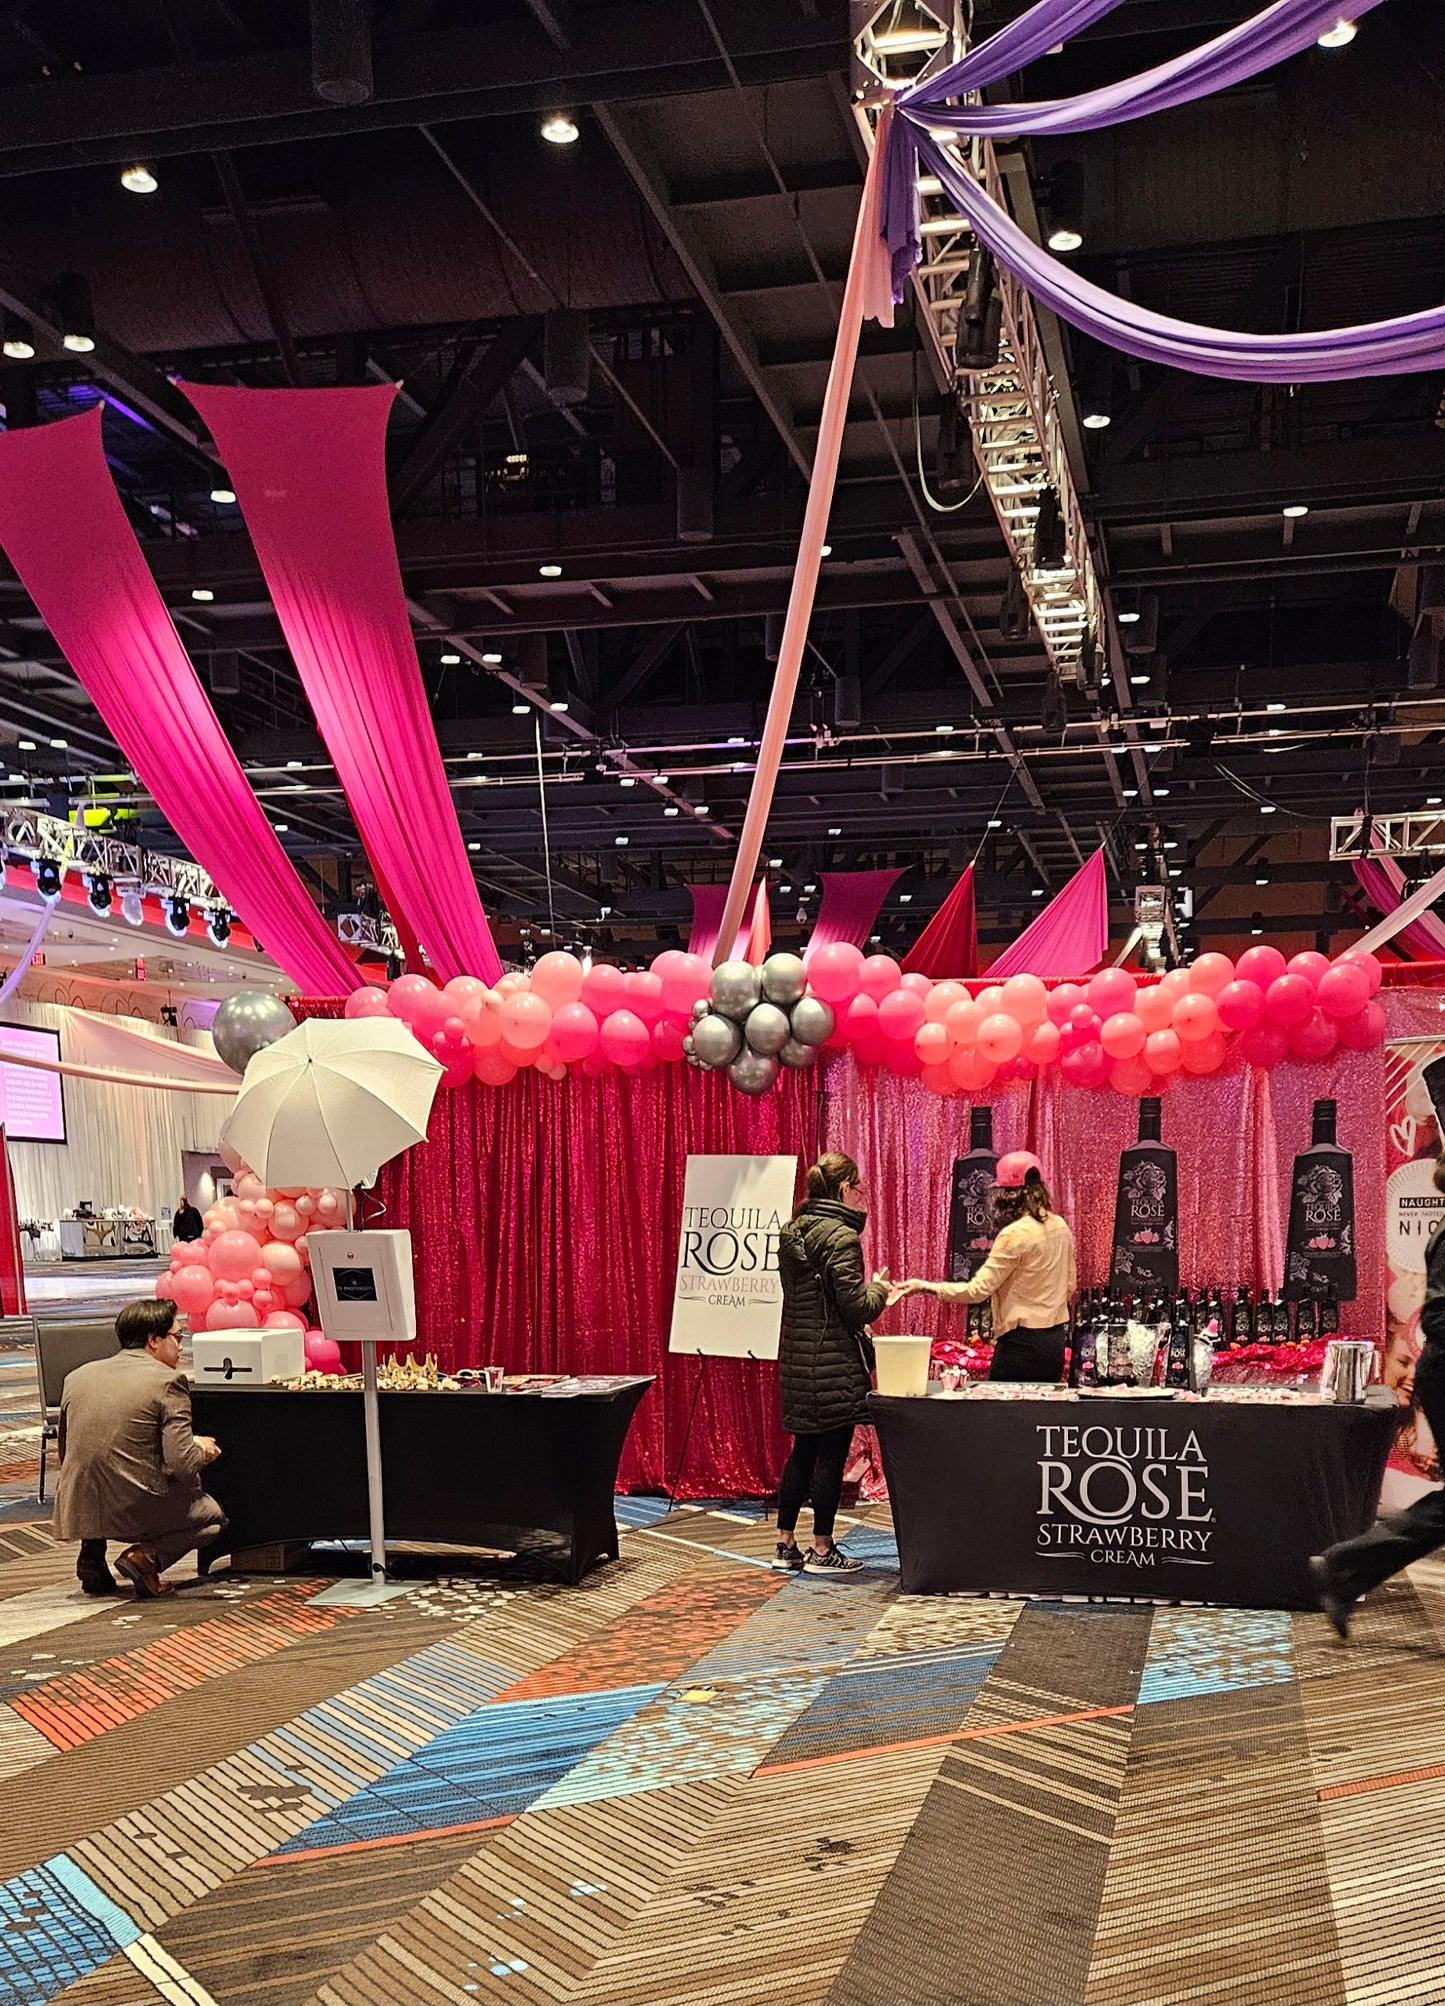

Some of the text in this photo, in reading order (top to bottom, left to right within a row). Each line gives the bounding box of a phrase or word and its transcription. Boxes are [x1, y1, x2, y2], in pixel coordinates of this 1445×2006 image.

[1131, 1205, 1165, 1218] ROSE
[1305, 1209, 1342, 1223] ROSE
[685, 1207, 781, 1236] TEQUILA
[681, 1231, 781, 1276] ROSE
[679, 1275, 779, 1294] STRAWBERRY
[708, 1294, 746, 1309] CREAM
[1036, 1425, 1207, 1470] TEQUILA
[1037, 1523, 1213, 1552] STRAWBERRY
[1090, 1549, 1156, 1568] CREAM
